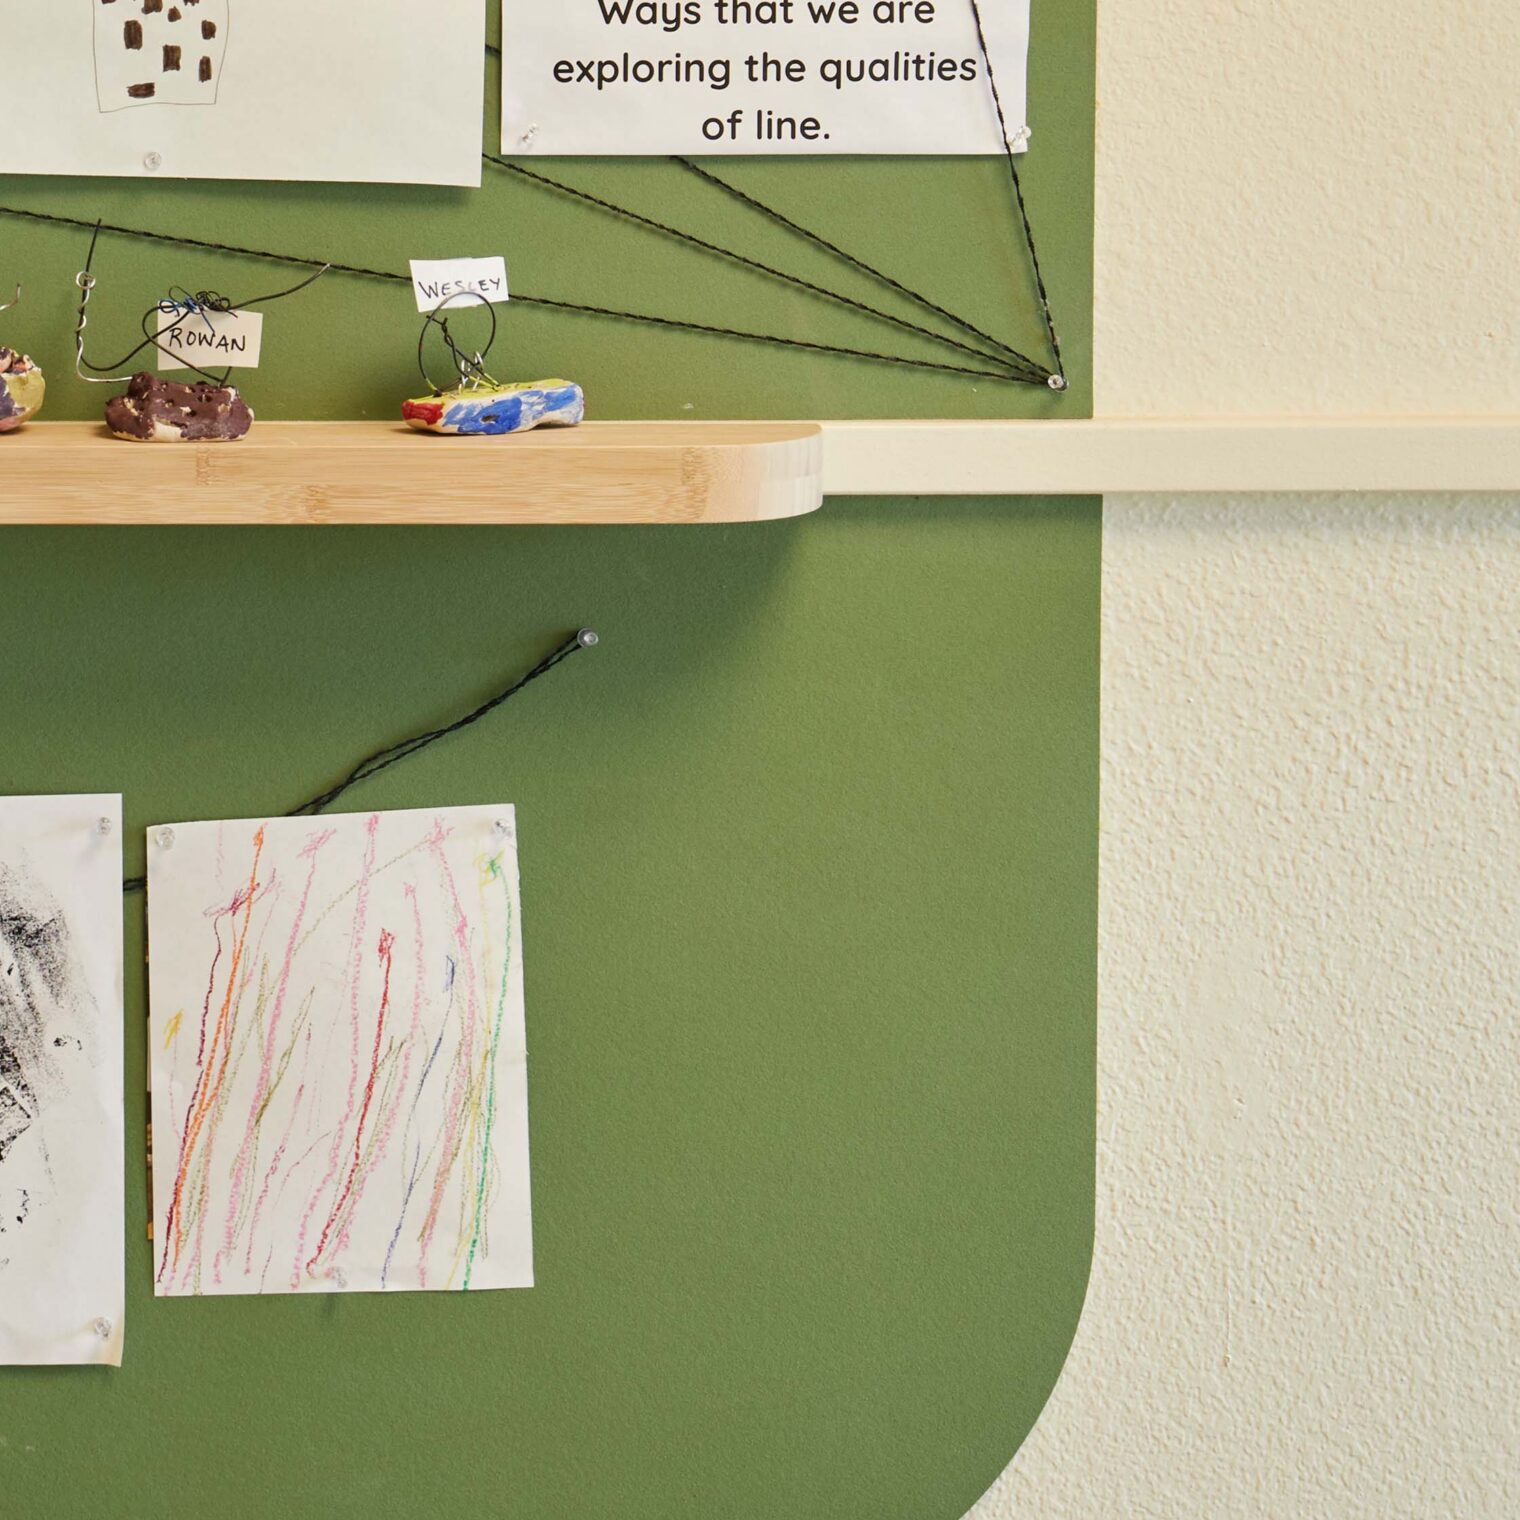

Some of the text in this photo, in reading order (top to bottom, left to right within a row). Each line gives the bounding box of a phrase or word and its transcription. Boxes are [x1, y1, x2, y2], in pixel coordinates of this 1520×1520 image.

[807, 0, 860, 24] we
[872, 0, 936, 24] are
[552, 51, 978, 91] exploring the qualities
[701, 109, 832, 141] of line.
[417, 277, 501, 299] WESLEY
[168, 327, 246, 353] ROWAN
